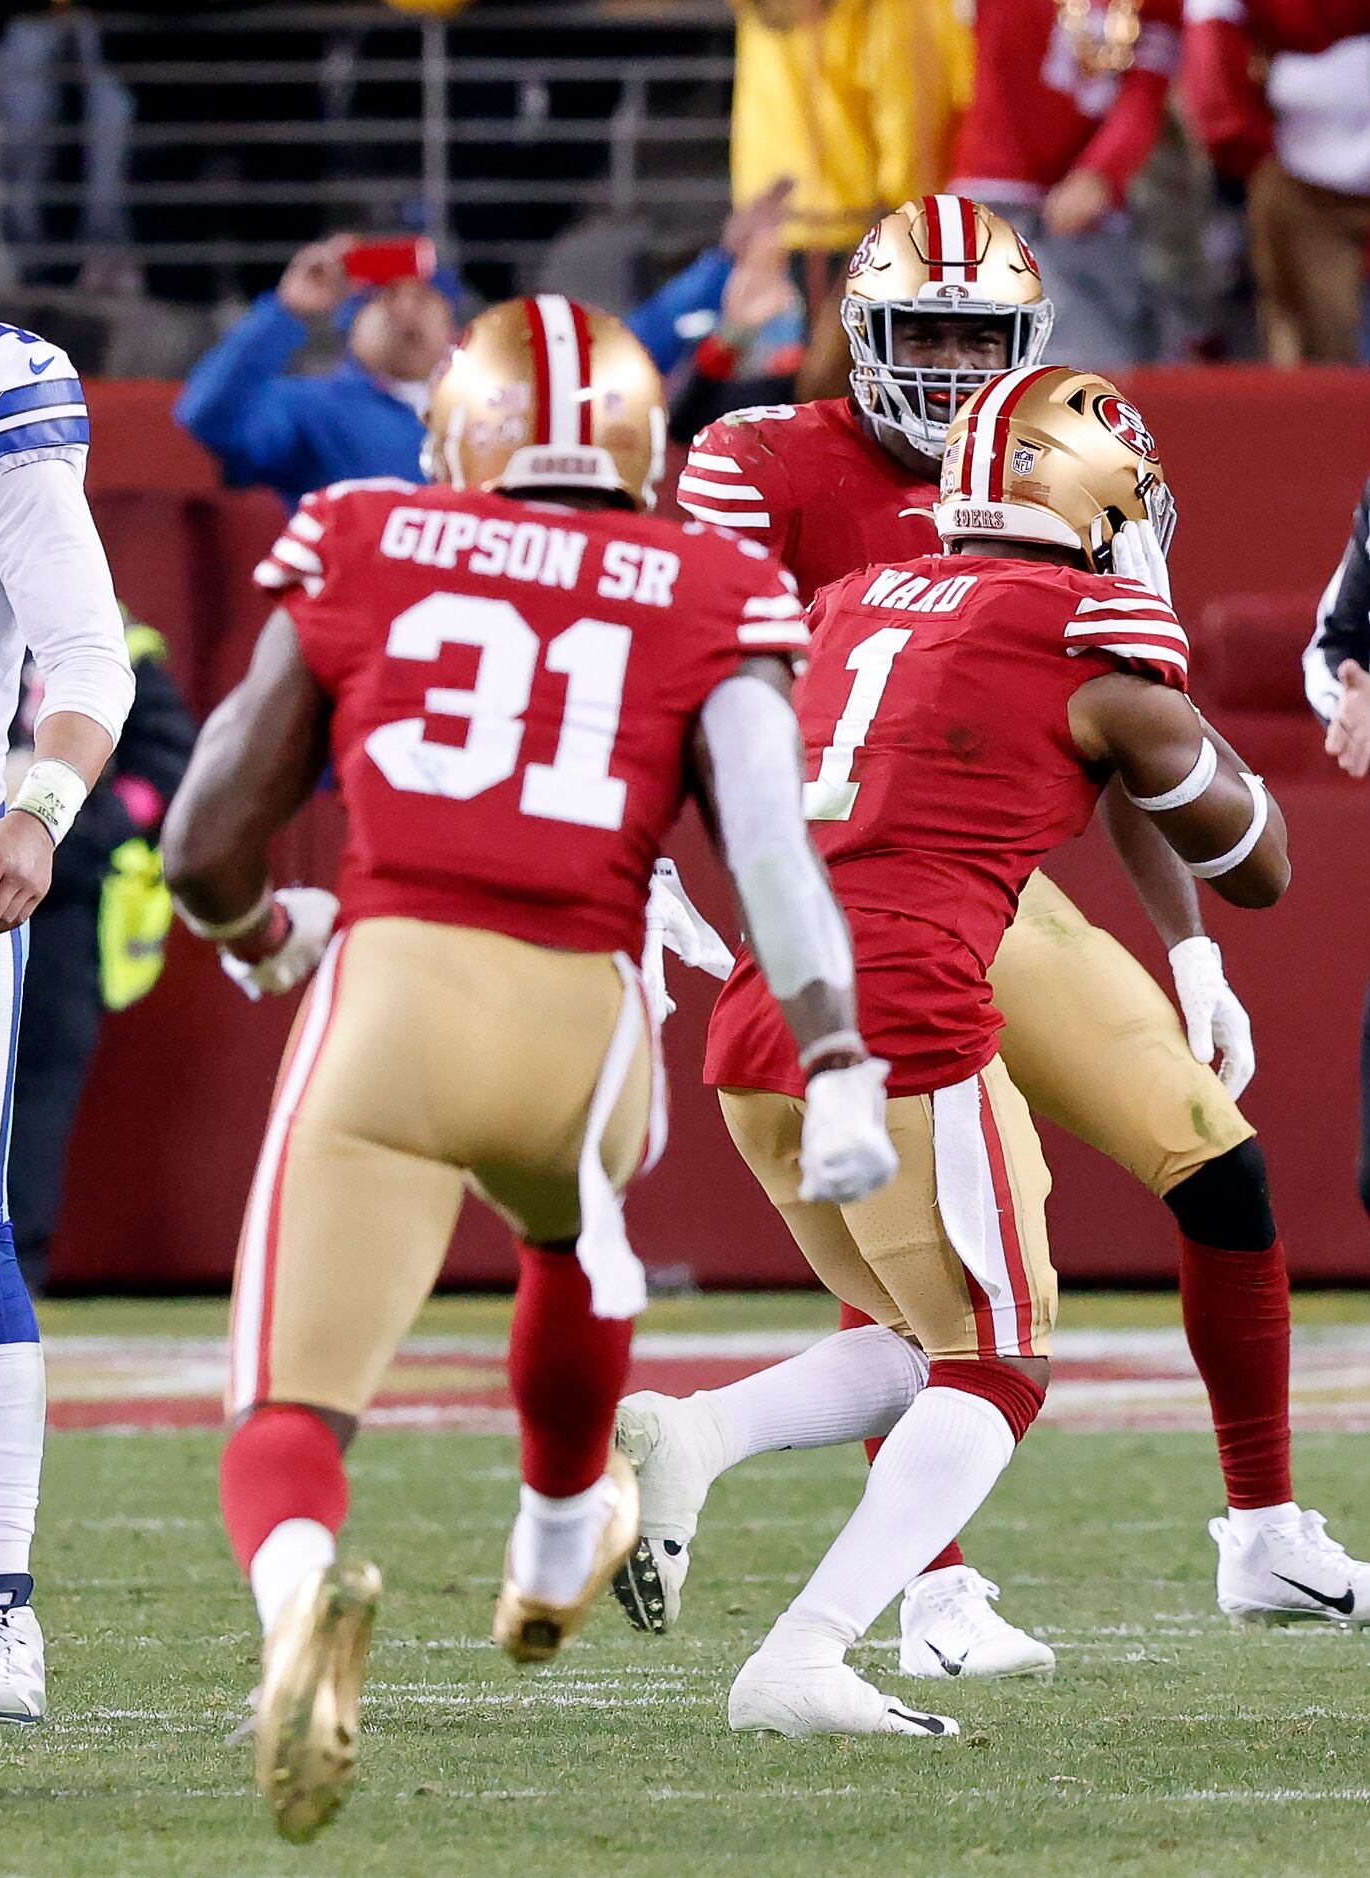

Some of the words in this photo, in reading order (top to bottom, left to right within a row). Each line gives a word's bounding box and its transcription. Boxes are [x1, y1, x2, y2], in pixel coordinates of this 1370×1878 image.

[1013, 459, 1032, 473] NFL
[953, 508, 1005, 530] 49ERS
[380, 506, 588, 589] GIPSON
[597, 540, 680, 607] SR
[860, 568, 979, 613] WARD
[364, 590, 632, 831] 31
[802, 627, 914, 821] 1
